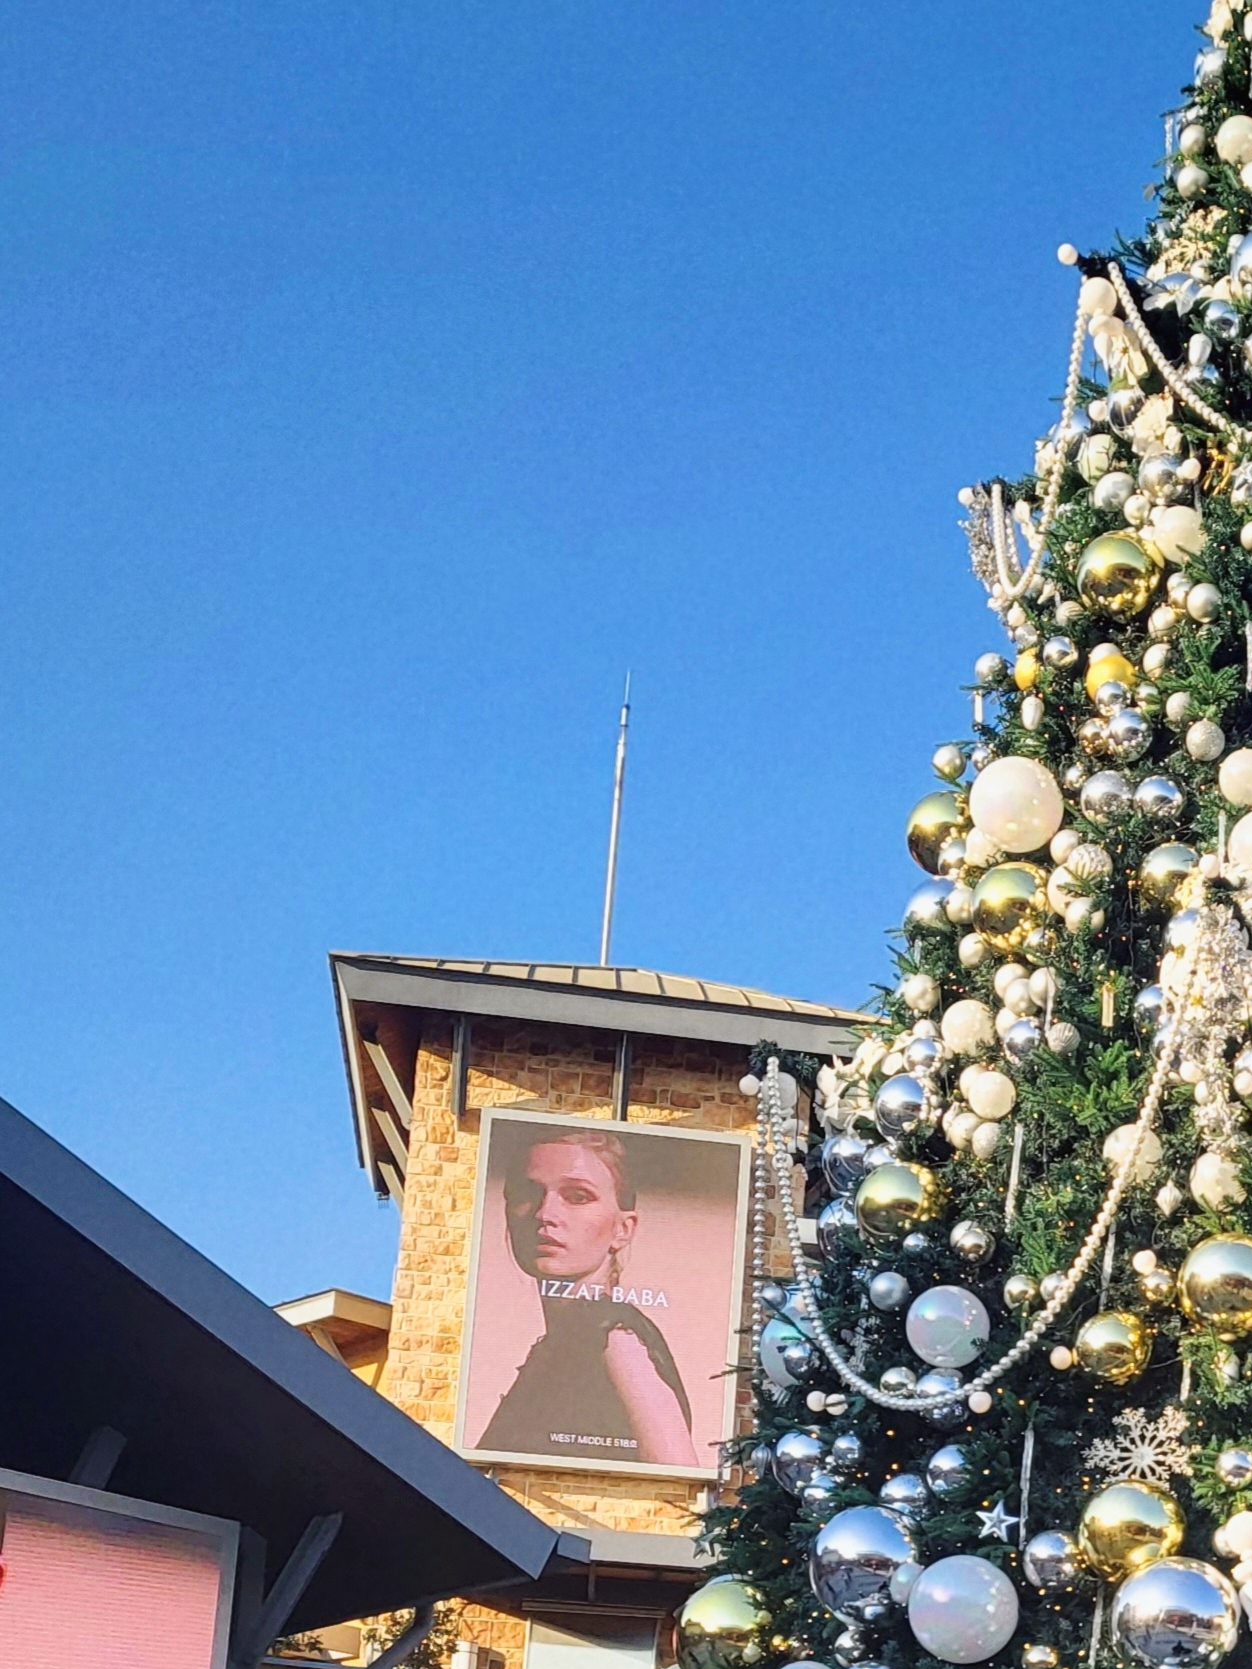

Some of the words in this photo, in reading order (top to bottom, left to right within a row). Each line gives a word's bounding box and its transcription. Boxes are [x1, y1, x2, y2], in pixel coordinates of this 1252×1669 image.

[540, 1279, 605, 1301] IZZAT
[611, 1286, 669, 1308] BABA
[549, 1432, 576, 1444] WEST
[577, 1434, 613, 1447] MIDDLE
